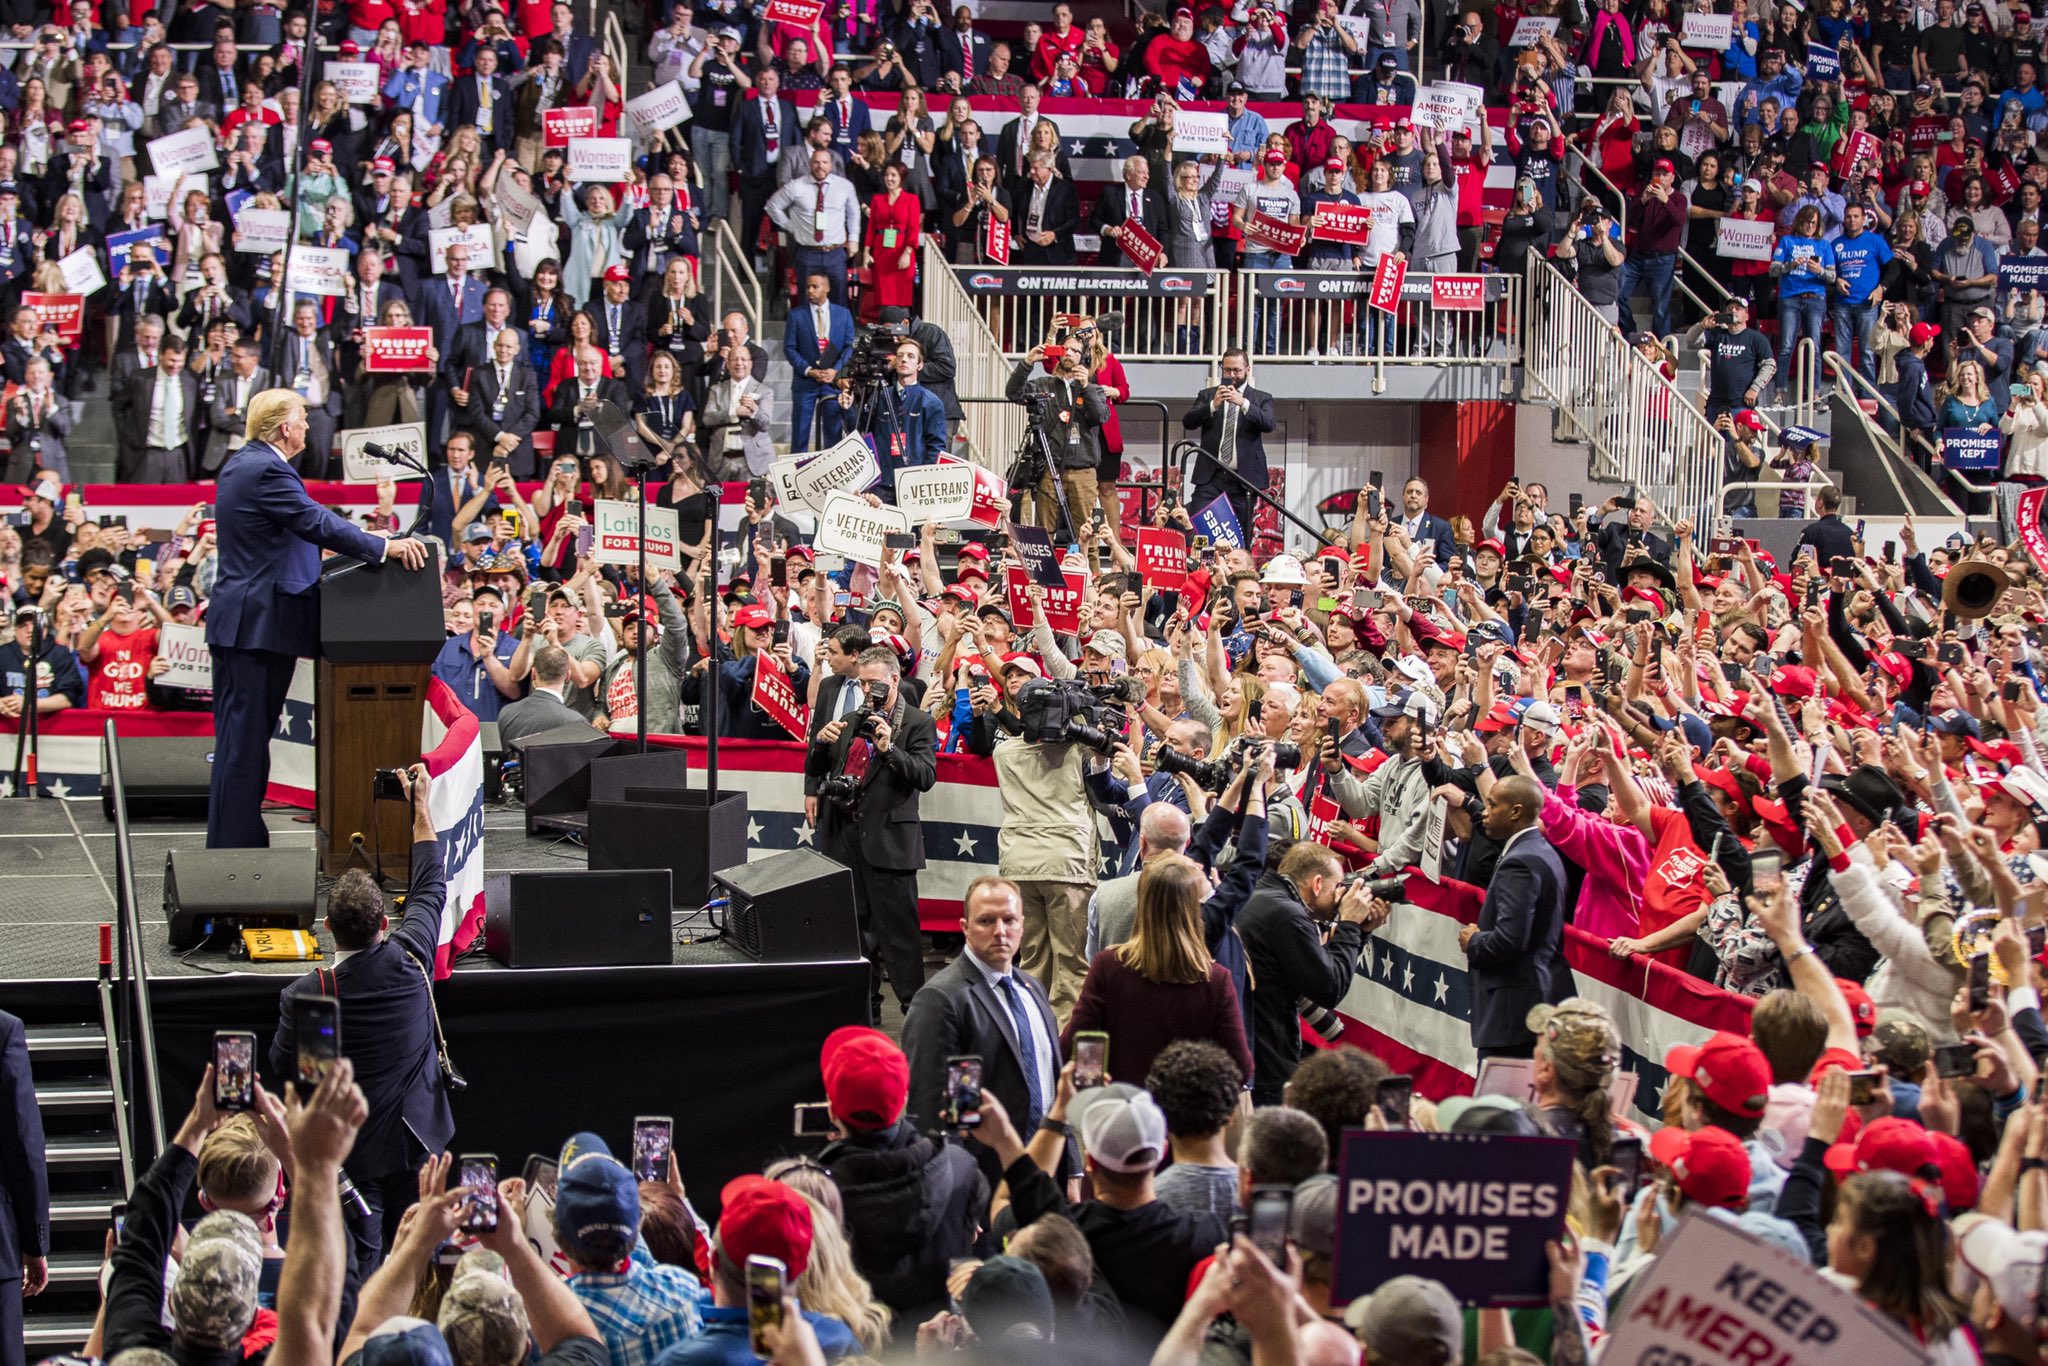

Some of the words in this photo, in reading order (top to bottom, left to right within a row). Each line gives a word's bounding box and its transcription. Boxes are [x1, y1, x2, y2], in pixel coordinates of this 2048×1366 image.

[1686, 21, 1728, 35] Women
[1809, 54, 1840, 68] PROMISES
[1816, 64, 1834, 75] KEPT
[1430, 94, 1455, 104] KEEP
[632, 95, 682, 123] Women
[1417, 102, 1463, 117] AMERICA
[546, 118, 593, 128] TRUMP
[1177, 121, 1224, 137] Women
[572, 150, 627, 164] Women
[1259, 199, 1288, 208] TRUMP
[1254, 220, 1300, 239] TRUMP
[1723, 228, 1769, 245] Women
[1124, 226, 1157, 257] TRUMP
[1264, 230, 1295, 245] ENCE
[1123, 235, 1151, 261] PENCE
[1837, 249, 1868, 259] TRUMP
[1017, 277, 1041, 289] ON
[1041, 277, 1077, 289] TIME
[1078, 278, 1149, 290] ELECTRICAL
[1377, 257, 1394, 304] TRUMP
[1435, 281, 1480, 290] TRUMP
[2009, 275, 2039, 284] MADE
[1318, 281, 1342, 293] ON
[371, 339, 428, 349] TRUMP
[376, 348, 424, 356] PENCE
[1946, 438, 1999, 449] PROMISES
[1960, 449, 1987, 459] KEPT
[809, 450, 866, 493] VETERANS
[840, 465, 865, 487] TRUMP
[910, 481, 969, 499] VETERANS
[919, 497, 936, 506] FOR
[938, 496, 963, 505] TRUMP
[841, 530, 858, 540] FOR
[605, 539, 630, 549] FOR
[1020, 598, 1072, 611] PNCE
[172, 662, 193, 671] FOR
[113, 681, 133, 694] WE
[100, 690, 147, 707] TRUMP
[759, 681, 806, 726] TRUMP
[1347, 1179, 1559, 1218] PROMISES
[1389, 1225, 1510, 1260] MADE
[1715, 1262, 1842, 1348] KEEP
